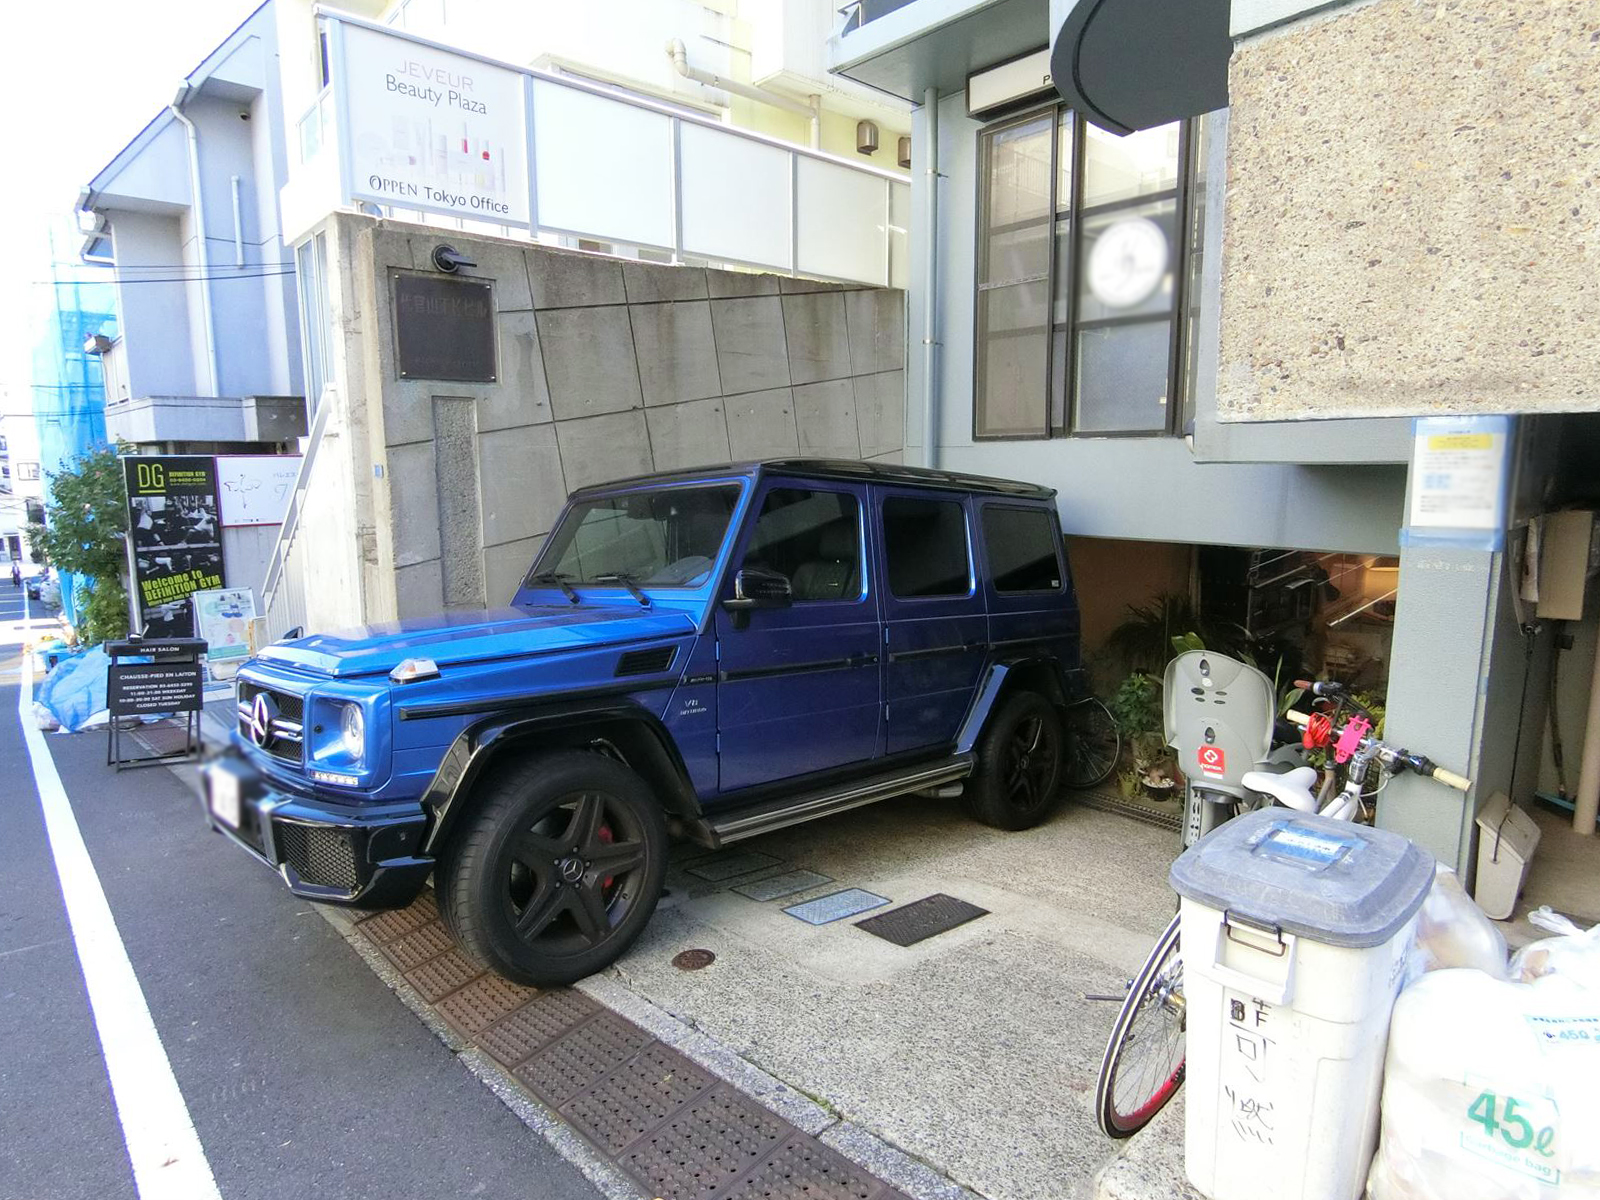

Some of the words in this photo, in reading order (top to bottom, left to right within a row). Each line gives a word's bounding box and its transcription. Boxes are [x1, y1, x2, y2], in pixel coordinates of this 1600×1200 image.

[395, 59, 474, 92] JEVEUR
[386, 73, 443, 107] Beauty
[449, 90, 487, 115] Plaza
[369, 174, 418, 196] OPPEN
[424, 186, 466, 208] Tokyo
[470, 195, 509, 214] Office
[137, 463, 165, 488] DG
[141, 573, 190, 591] Welcome
[191, 570, 203, 579] to
[144, 580, 197, 601] DEFINITION
[199, 575, 221, 588] GYM
[1525, 1156, 1552, 1177] bag
